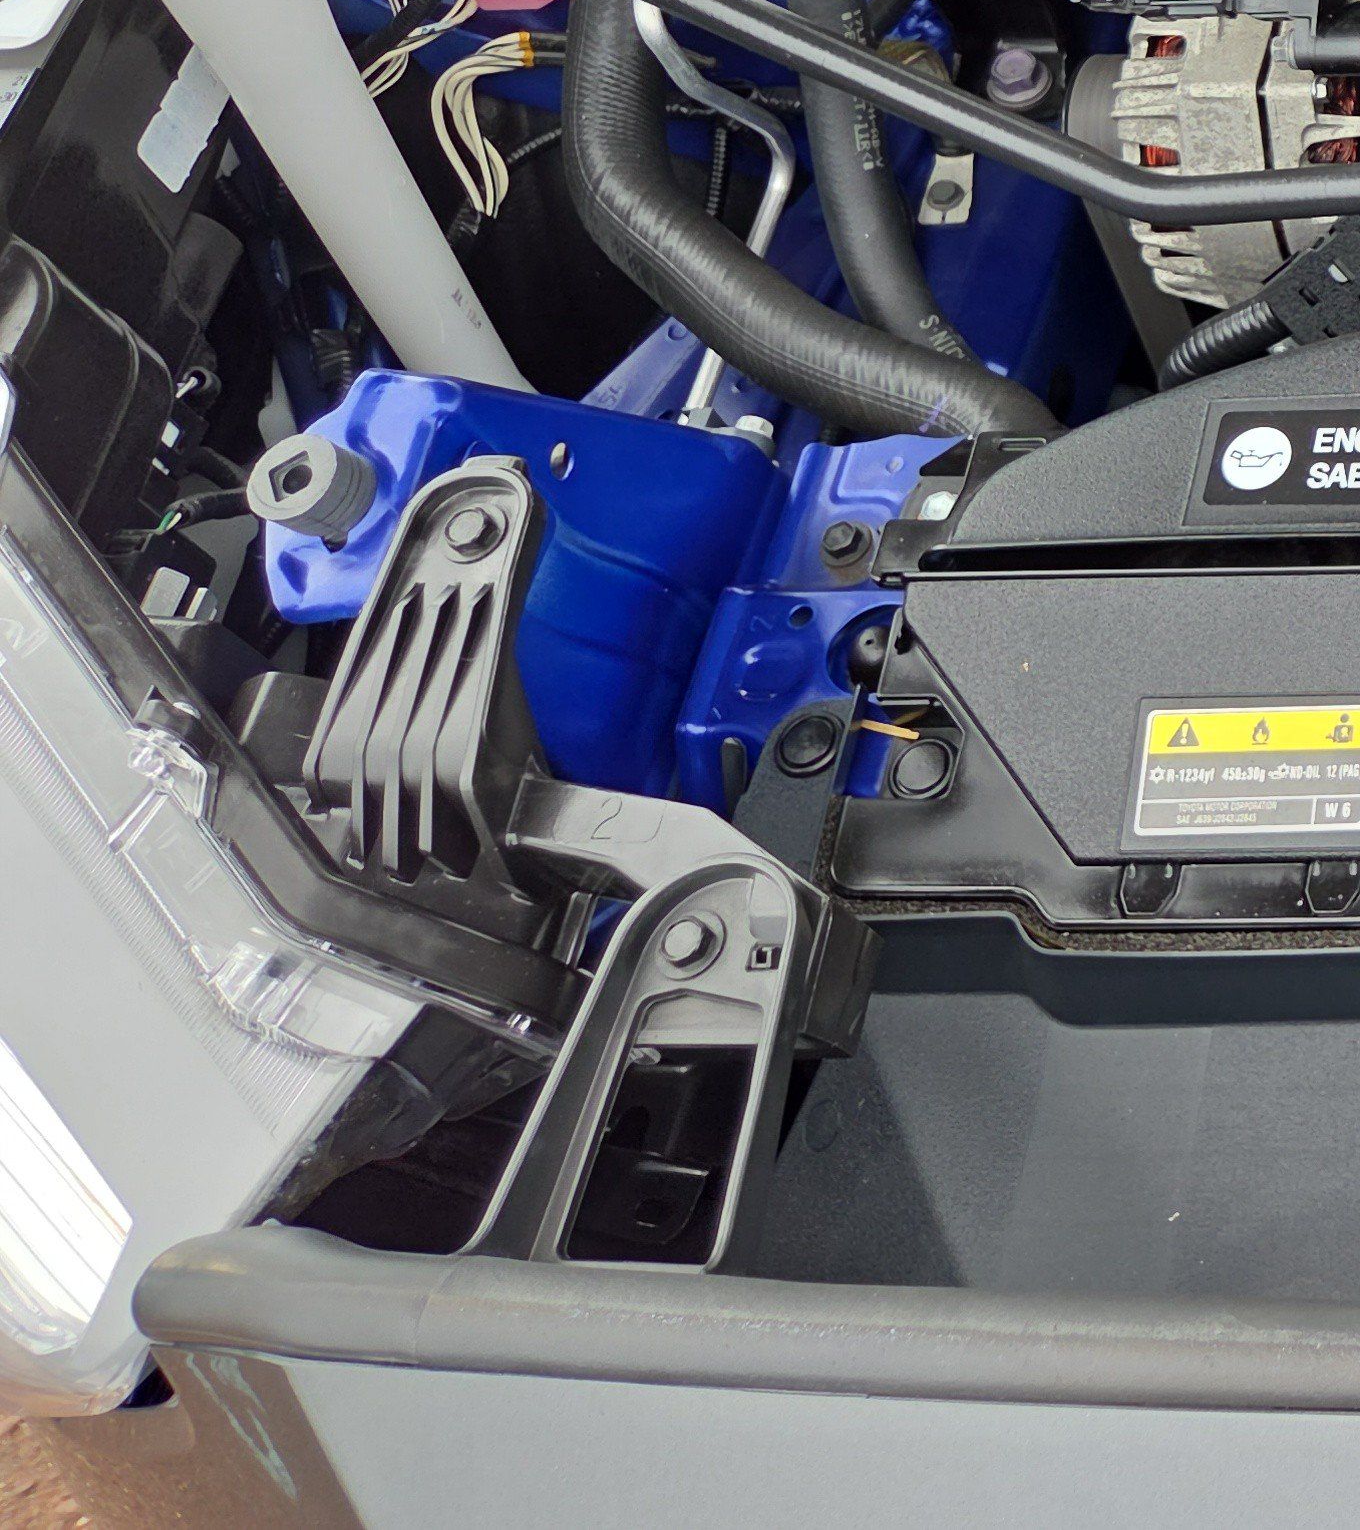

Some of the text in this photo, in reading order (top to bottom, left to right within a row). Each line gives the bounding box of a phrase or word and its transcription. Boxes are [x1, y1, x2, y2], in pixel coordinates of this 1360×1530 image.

[1326, 764, 1338, 779] 12
[1324, 802, 1352, 819] W 6
